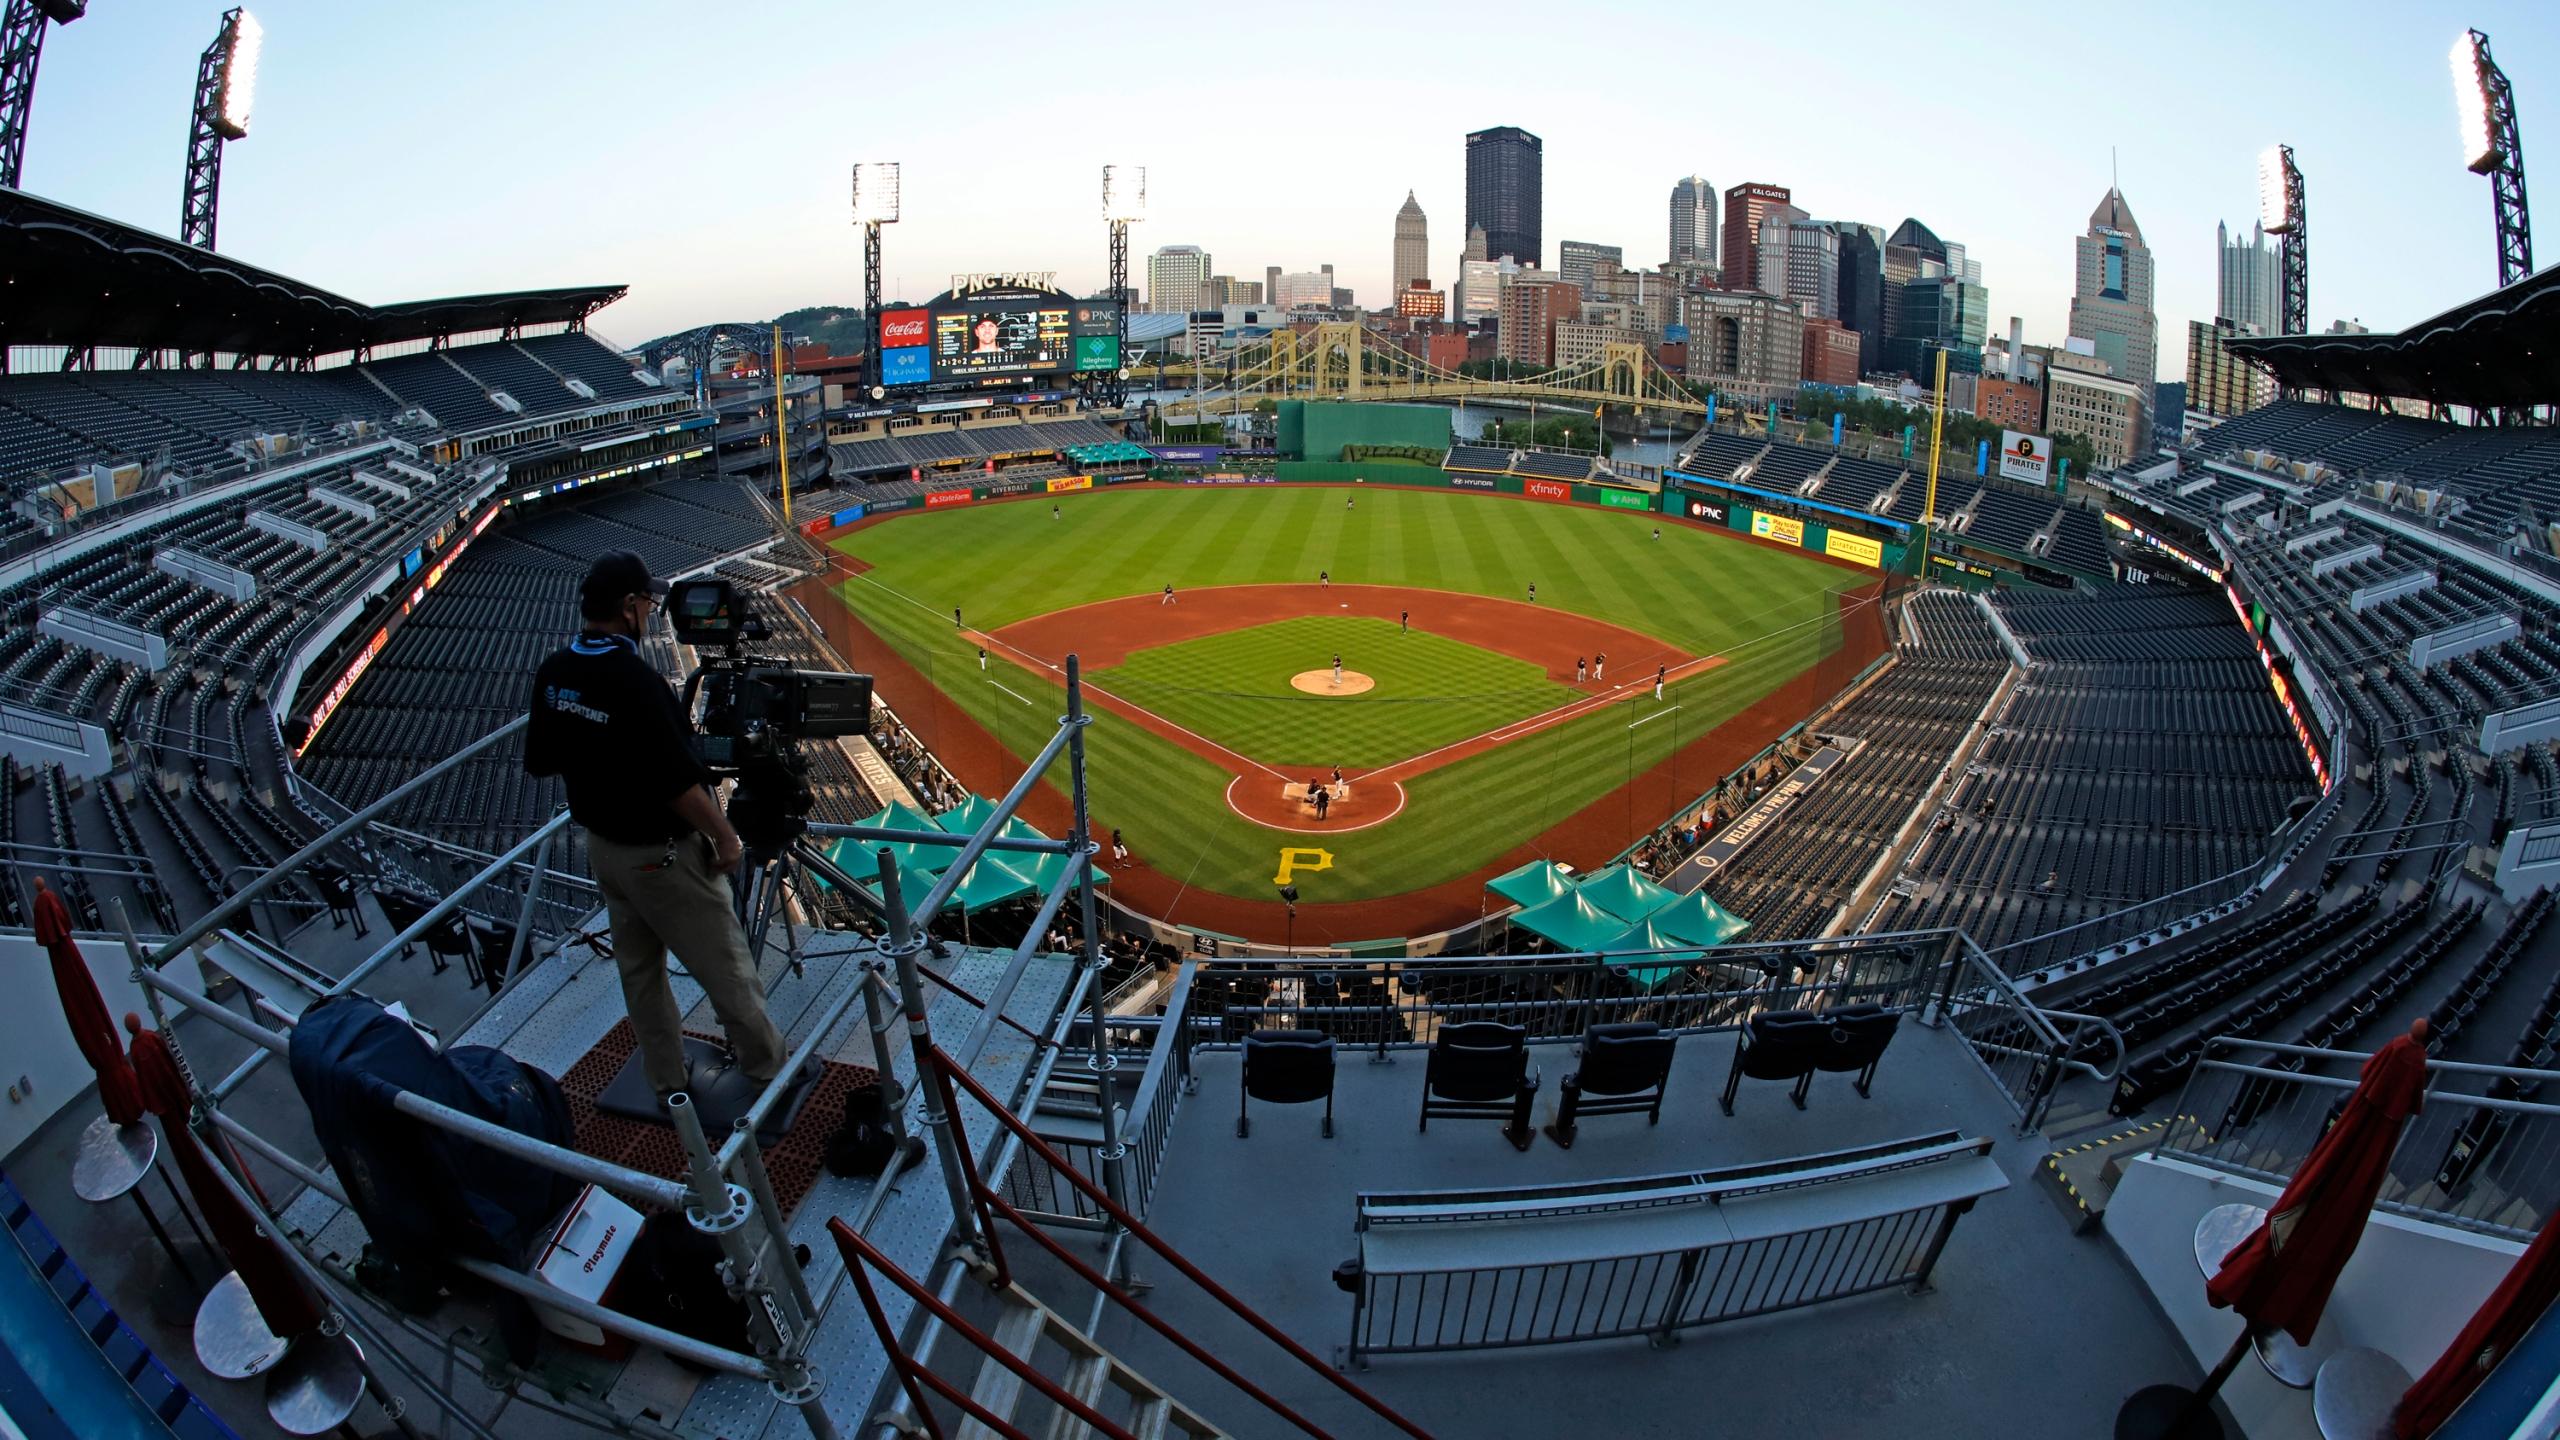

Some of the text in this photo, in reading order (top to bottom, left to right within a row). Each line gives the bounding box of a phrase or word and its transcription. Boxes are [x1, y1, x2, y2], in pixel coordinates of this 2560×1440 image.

[1765, 190, 1786, 199] GATES
[952, 271, 1058, 300] PNC PARK
[1092, 310, 1115, 320] PNC
[867, 409, 892, 417] NETWORK
[2022, 442, 2030, 453] P
[2007, 457, 2041, 471] PIRATES
[992, 484, 1028, 494] RIVERDALE
[1530, 483, 1564, 498] xfinity
[1621, 495, 1641, 505] AHN
[1702, 506, 1722, 520] PNC
[1832, 540, 1875, 556] pirates.com
[2126, 566, 2150, 584] Lite
[2177, 579, 2188, 587] bar
[314, 704, 326, 727] OUT
[325, 691, 336, 710] THE
[557, 700, 609, 724] SPORTSNET
[854, 752, 892, 784] PIRATES
[1721, 812, 1767, 844] WELCOME
[1766, 794, 1788, 808] PNC
[1780, 780, 1805, 796] PARK
[1274, 848, 1334, 885] P
[164, 1027, 195, 1087] NIVERSAL
[584, 1225, 616, 1273] Playmate
